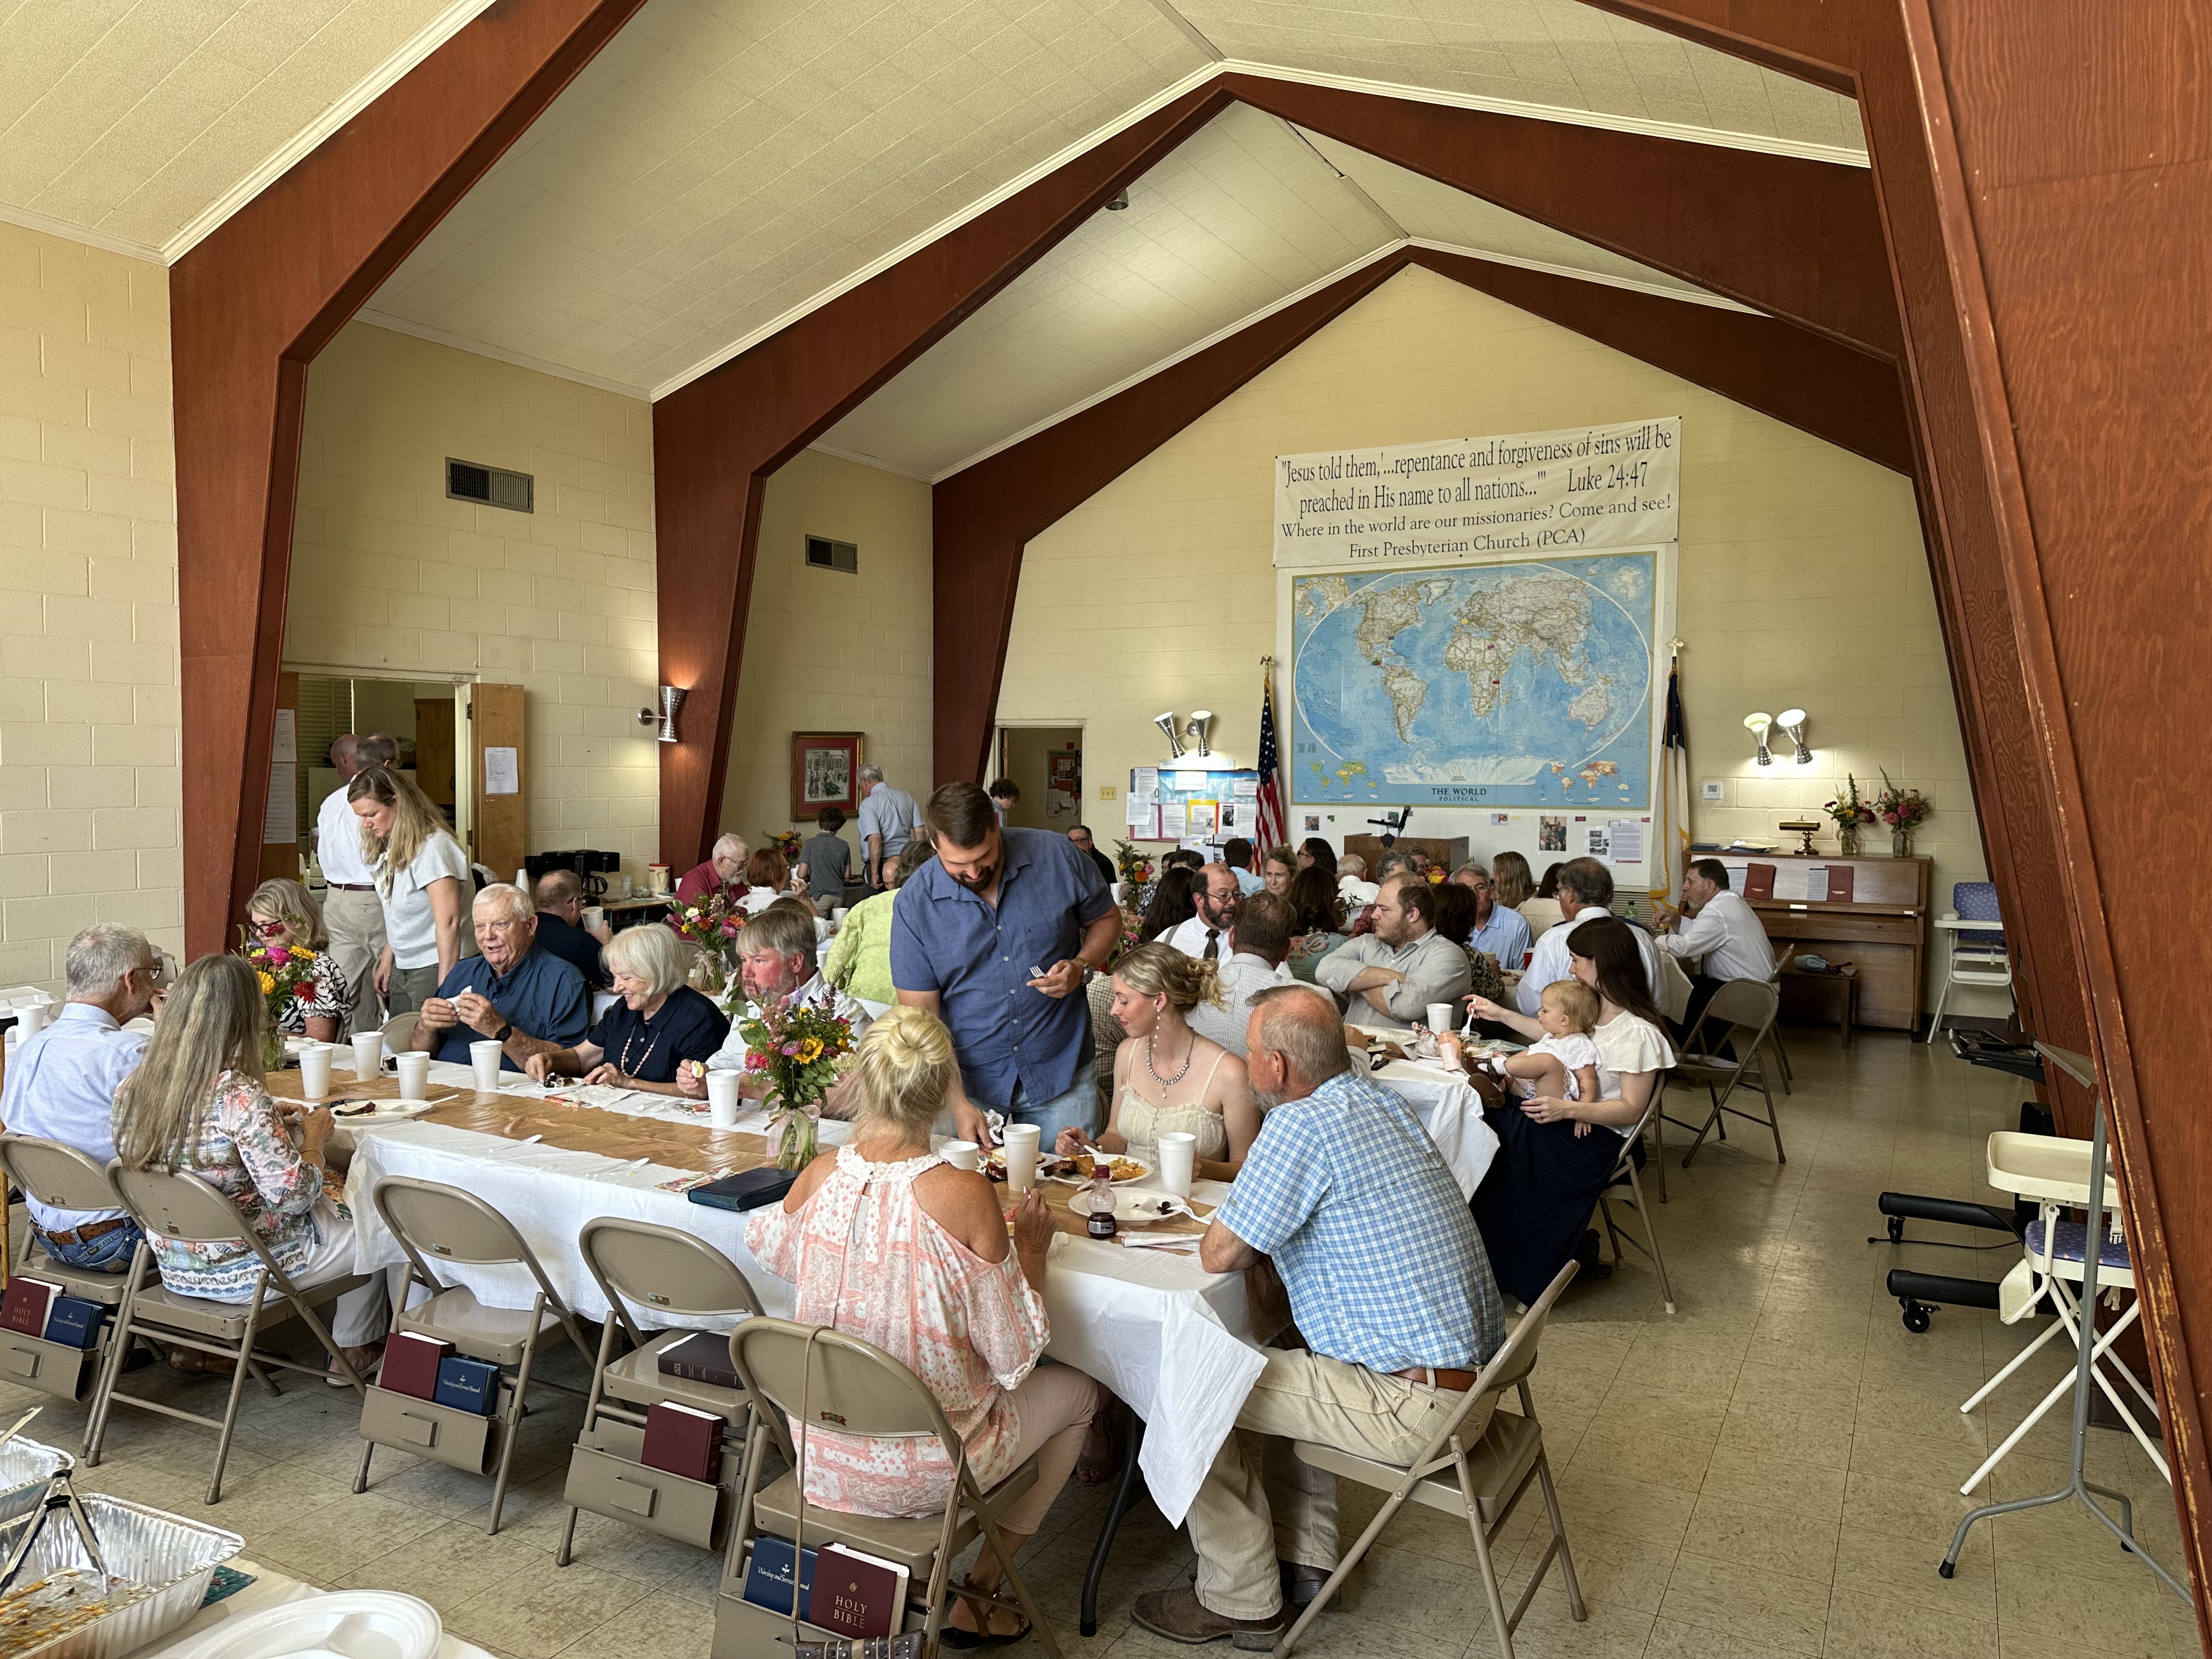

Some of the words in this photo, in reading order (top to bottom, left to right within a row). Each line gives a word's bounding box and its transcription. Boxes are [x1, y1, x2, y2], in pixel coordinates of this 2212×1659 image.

[1282, 460, 1315, 488] "Jesus
[1319, 455, 1341, 479] told
[1470, 441, 1494, 467] and
[1498, 439, 1572, 469] forgiveness
[1577, 431, 1593, 457] of
[1594, 433, 1620, 455] sins
[1625, 425, 1650, 452] will
[1655, 424, 1672, 449] be
[1300, 487, 1353, 519] preached
[1358, 489, 1370, 509] in
[1374, 485, 1395, 509] His
[1399, 489, 1434, 507] name
[1438, 486, 1451, 504] to
[1455, 476, 1471, 502] all
[1568, 466, 1602, 493] Luke
[1607, 461, 1647, 490] 24:47
[1282, 522, 1324, 538] Where
[1328, 522, 1340, 535] in
[1345, 518, 1364, 535] the
[1369, 516, 1406, 532] world
[1410, 518, 1430, 531] are
[1435, 517, 1458, 528] our
[1463, 504, 1554, 526] missionaries?
[1559, 501, 1604, 519] Come
[1609, 496, 1637, 514] and
[1641, 494, 1671, 511] see!
[1349, 543, 1379, 558] First
[1383, 539, 1469, 558] Presbyterian
[1474, 532, 1530, 551] Church
[1537, 527, 1585, 549] (PCA)
[12, 1315, 30, 1325] BIBLE
[14, 1306, 32, 1316] HOLY
[835, 1595, 867, 1614] HOLY
[833, 1609, 865, 1629] BIBLE
